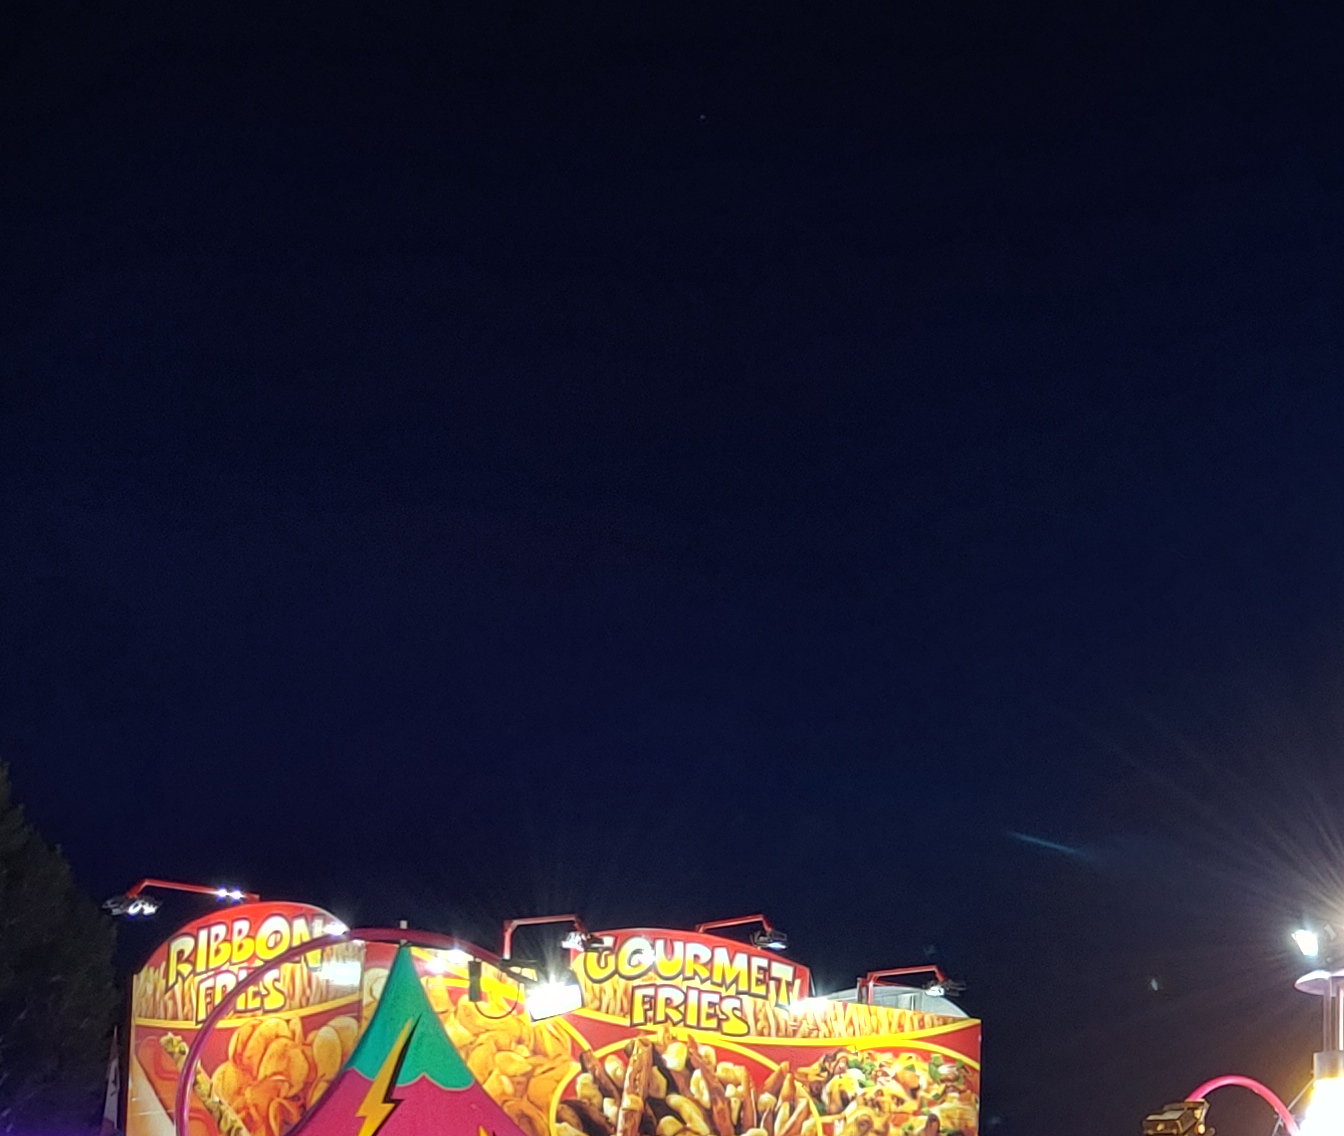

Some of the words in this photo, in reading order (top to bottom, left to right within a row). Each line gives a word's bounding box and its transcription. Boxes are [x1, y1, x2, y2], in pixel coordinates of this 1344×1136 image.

[164, 913, 328, 993] RIBBON
[584, 936, 795, 1006] GOURMET
[630, 984, 750, 1037] FRIES
